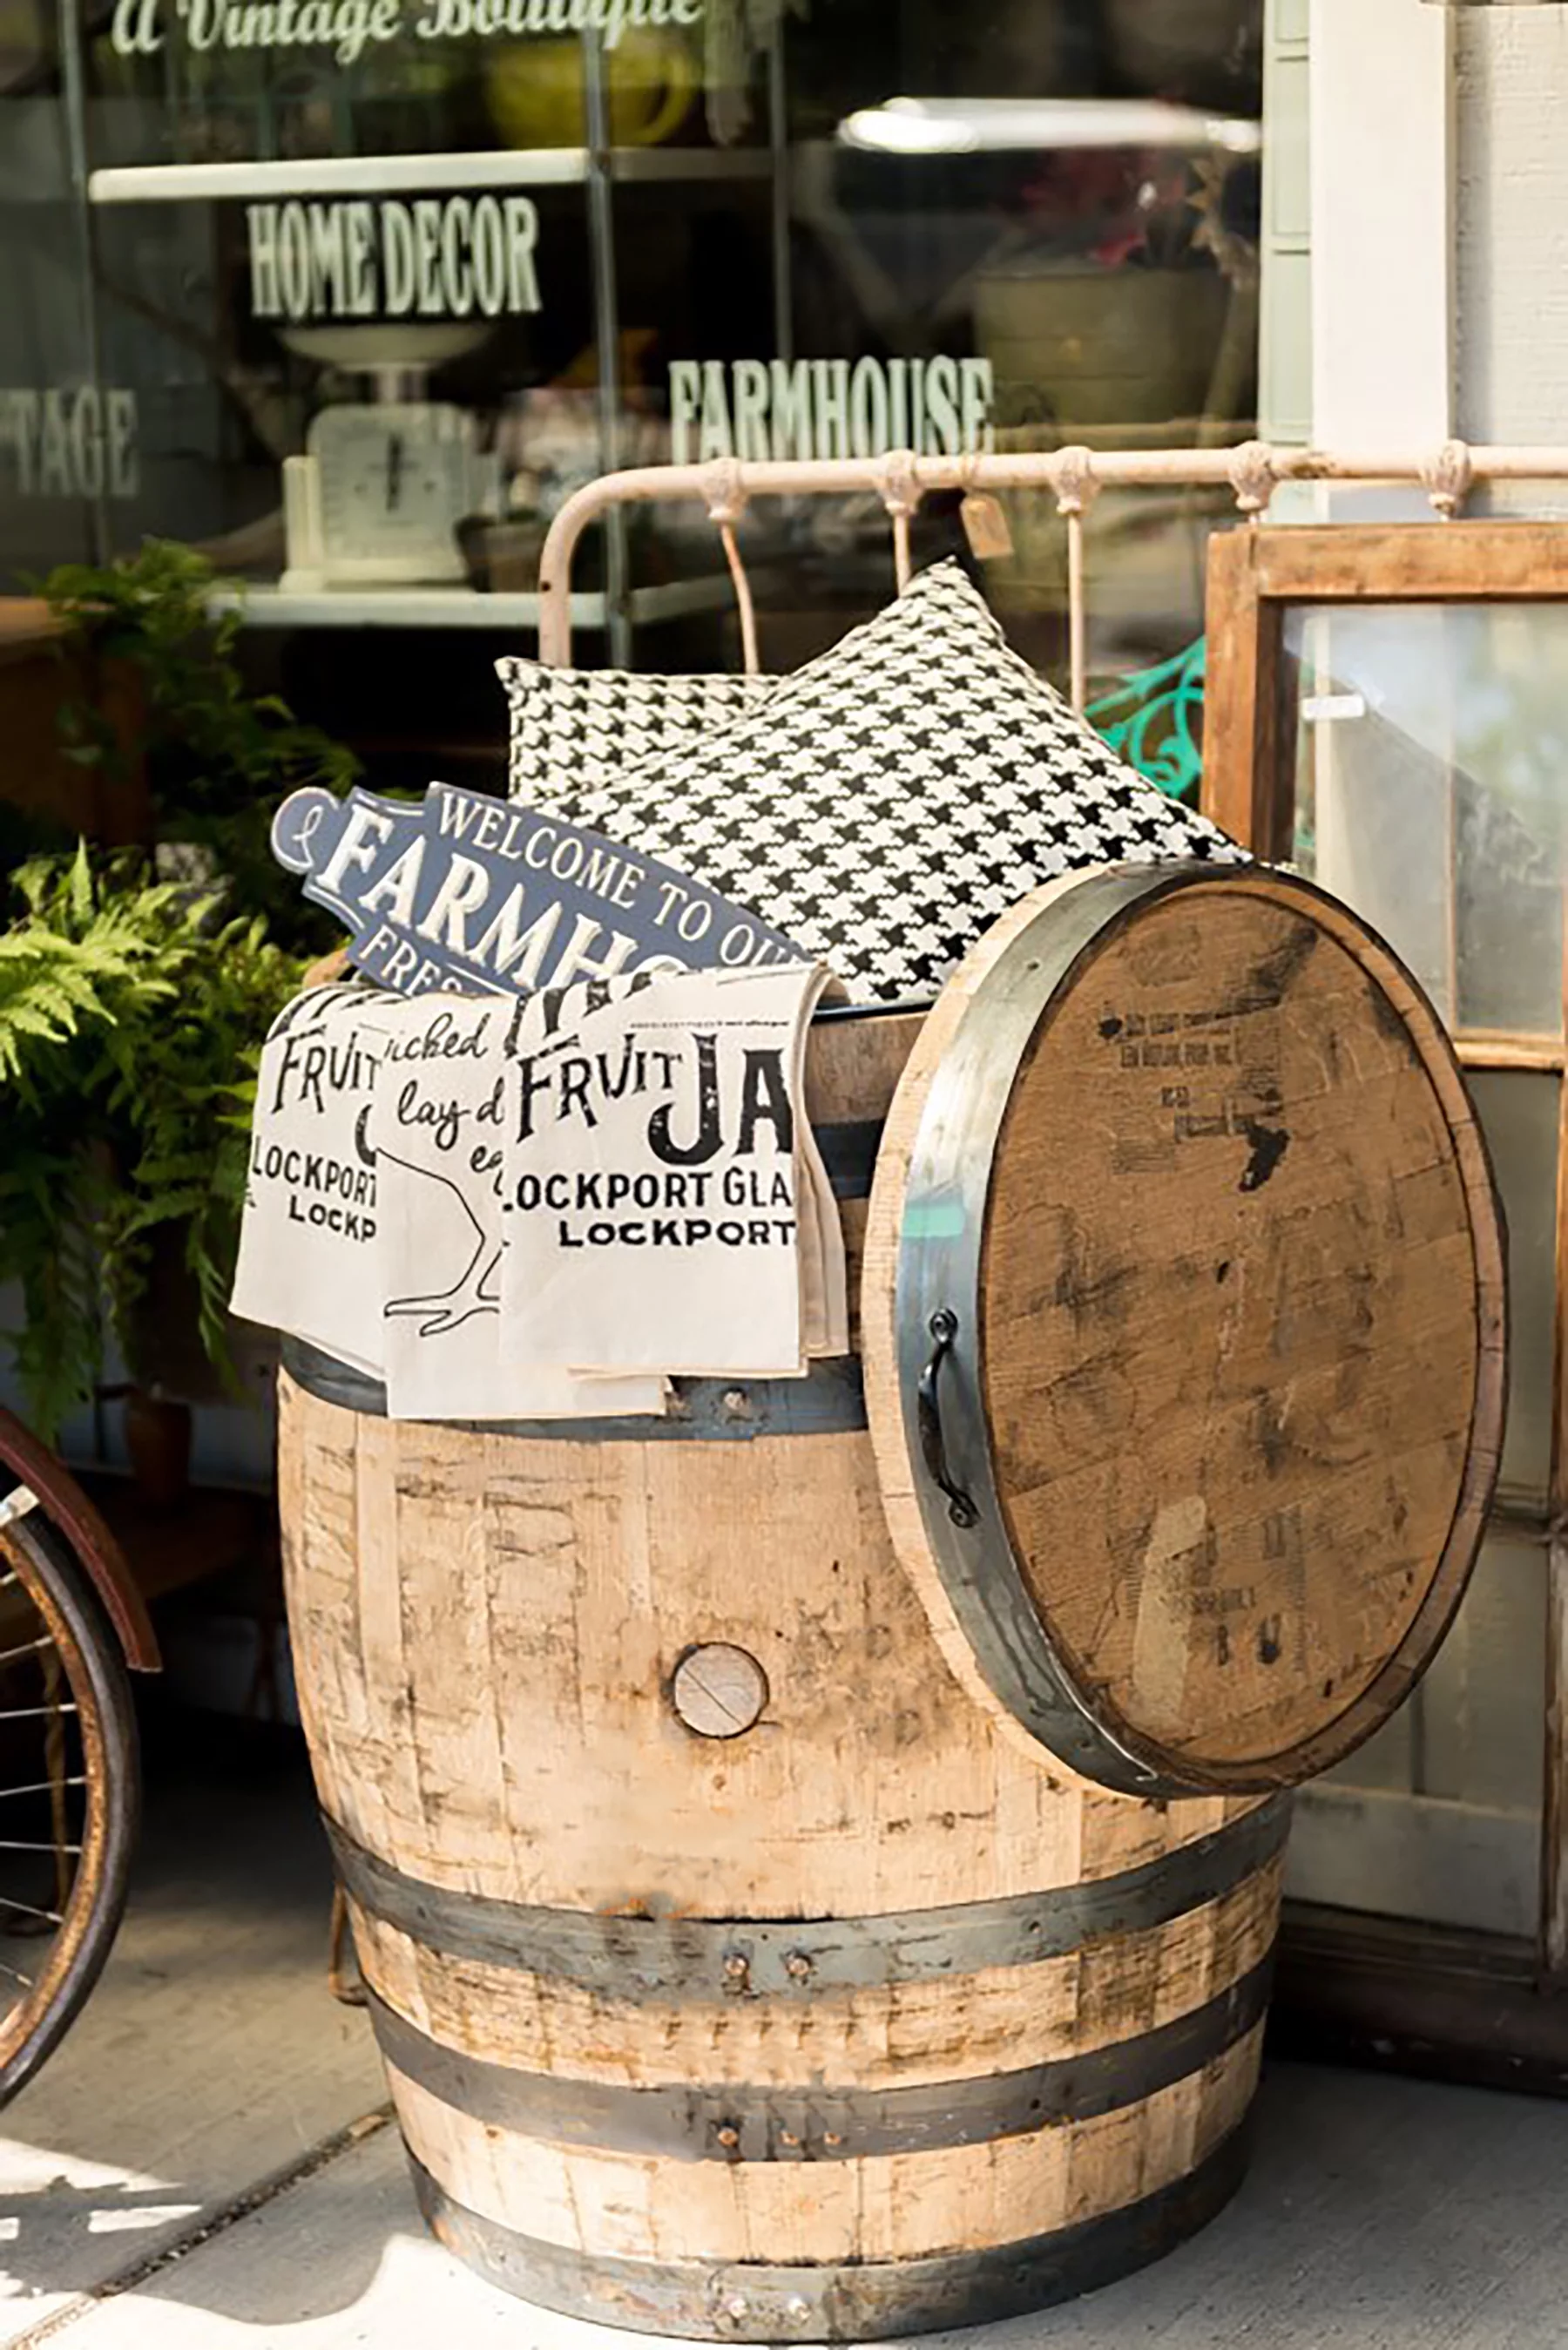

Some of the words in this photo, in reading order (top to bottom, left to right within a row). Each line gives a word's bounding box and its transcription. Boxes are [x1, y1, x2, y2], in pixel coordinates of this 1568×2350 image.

[175, 0, 402, 66] Vintage
[246, 201, 377, 320] HOME
[380, 195, 543, 316] DECOR
[668, 355, 995, 466] FARMHOUSE
[439, 791, 645, 910] WELCOME
[653, 881, 713, 942] TO
[720, 915, 803, 965] OU
[271, 1030, 382, 1115] FRUIT
[516, 1033, 683, 1144] FRUIT
[647, 1033, 794, 1167] JA
[397, 1080, 471, 1151] lay
[503, 1173, 713, 1212] OCKPORT
[723, 1166, 793, 1208] GLA
[559, 1220, 796, 1248] LOCKPORT
